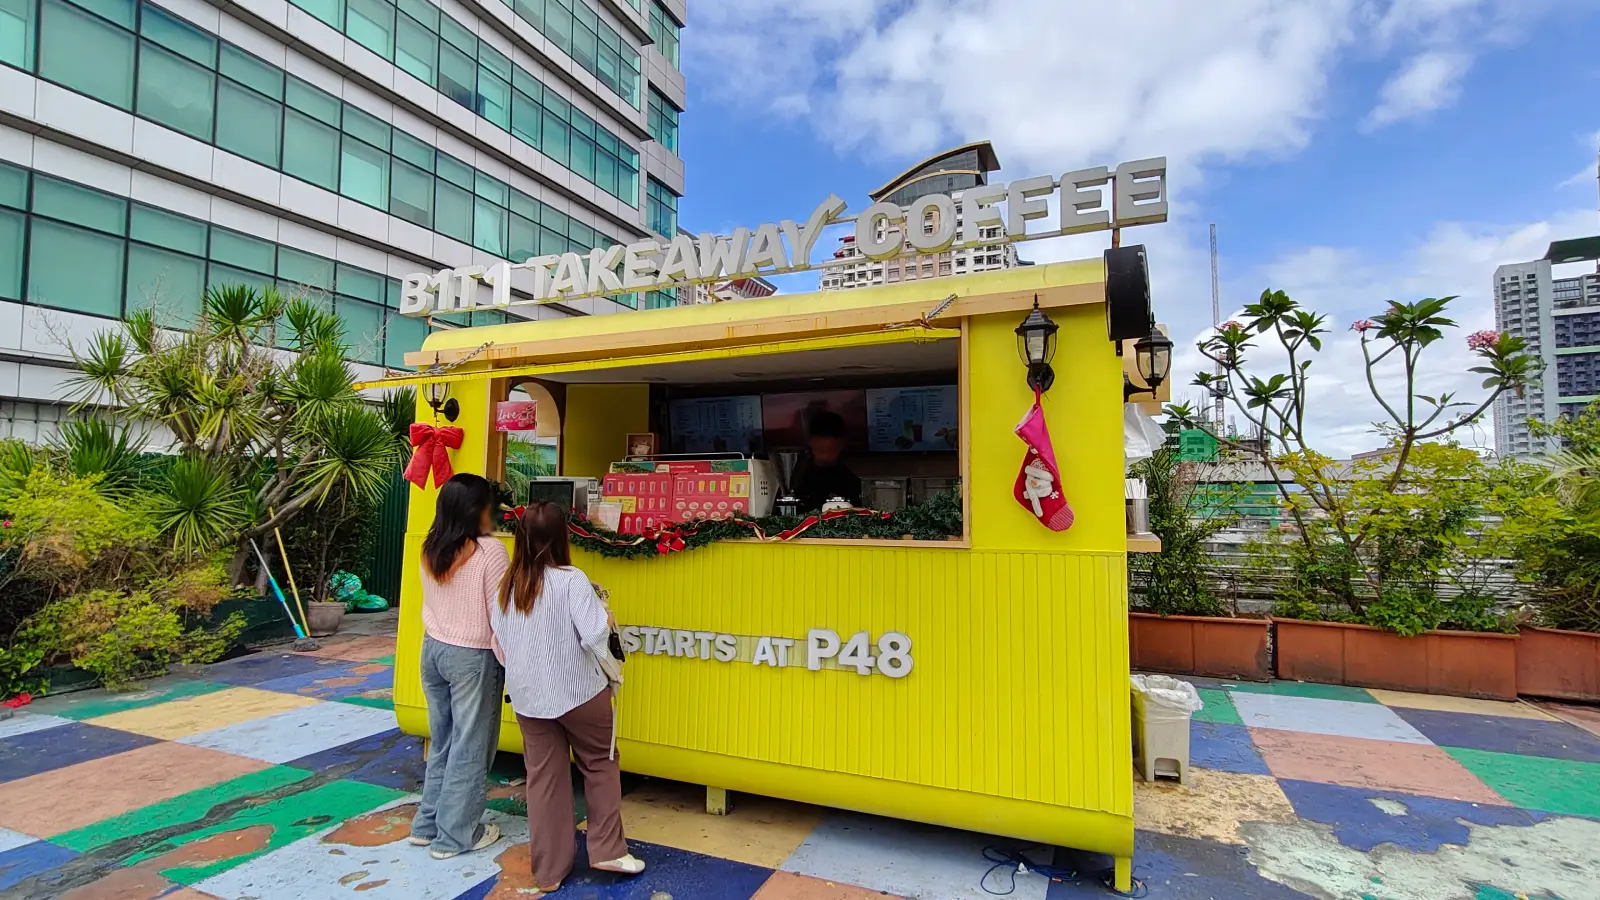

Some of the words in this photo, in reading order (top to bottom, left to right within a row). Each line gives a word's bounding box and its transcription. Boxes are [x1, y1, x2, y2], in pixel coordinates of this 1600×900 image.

[400, 262, 512, 317] B1T1
[525, 193, 848, 302] TAKEAWAY
[855, 156, 1168, 261] COFFEE
[621, 625, 737, 662] STARTS
[752, 636, 794, 668] AT
[807, 628, 914, 679] P48
